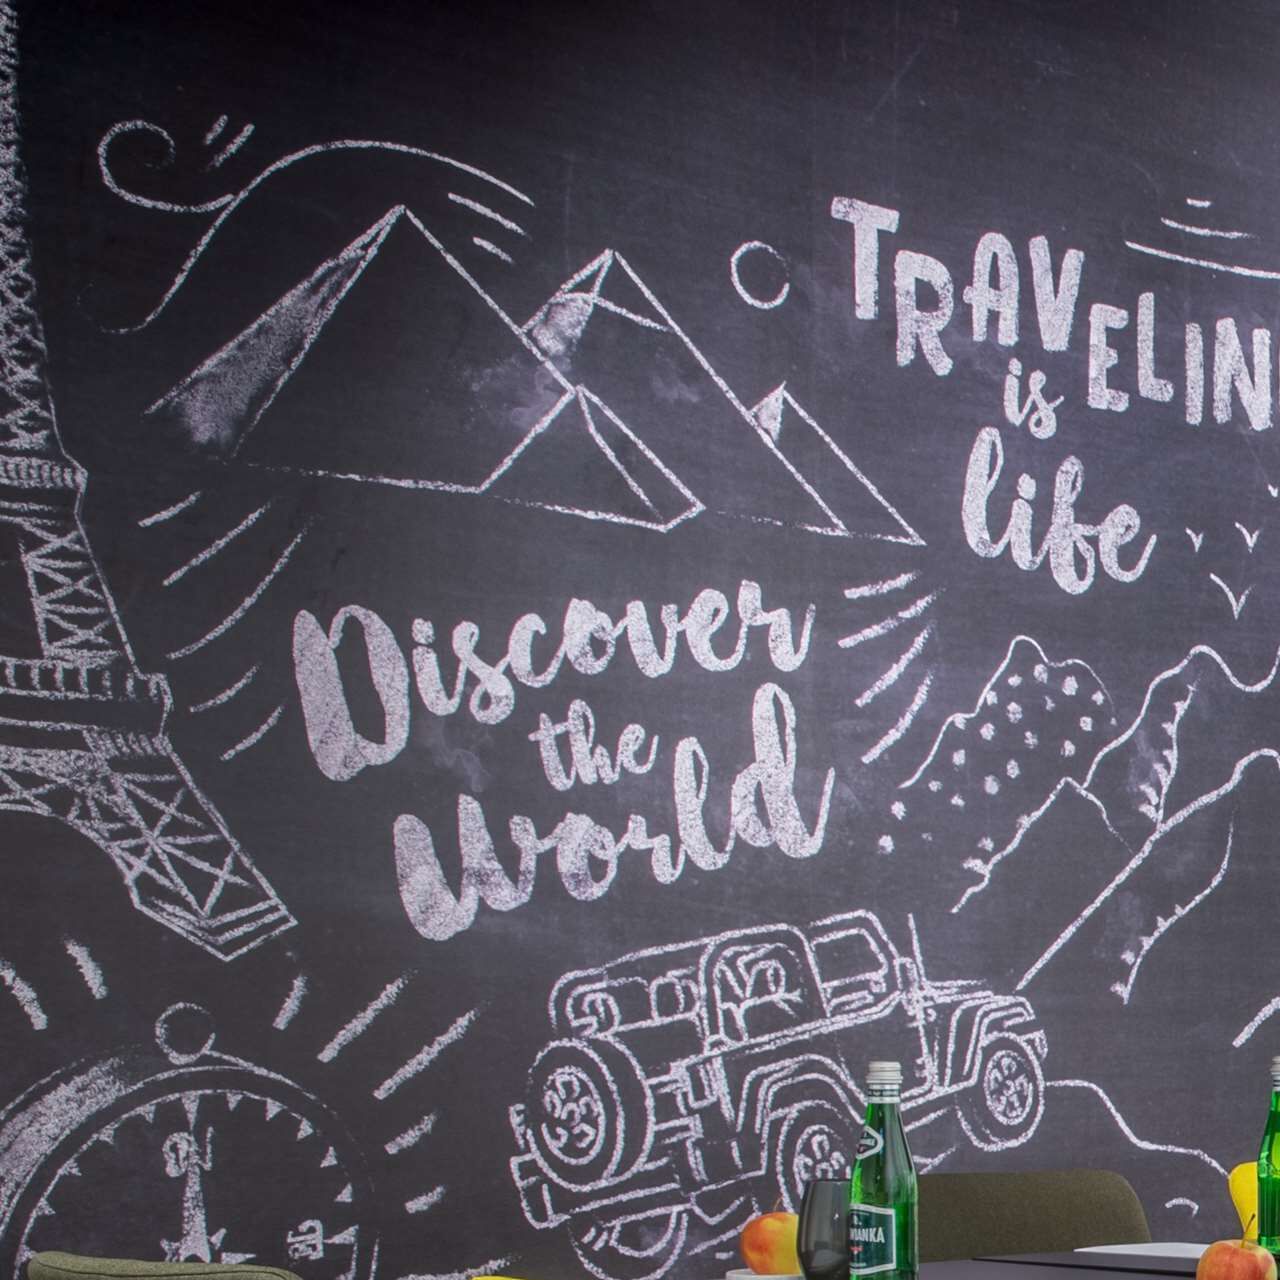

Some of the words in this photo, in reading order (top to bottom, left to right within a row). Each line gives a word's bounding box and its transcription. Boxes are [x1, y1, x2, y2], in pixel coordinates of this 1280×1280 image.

[1003, 357, 1064, 439] is
[960, 426, 1157, 595] life
[293, 580, 815, 781] Discover
[528, 699, 658, 792] the
[393, 682, 836, 941] World
